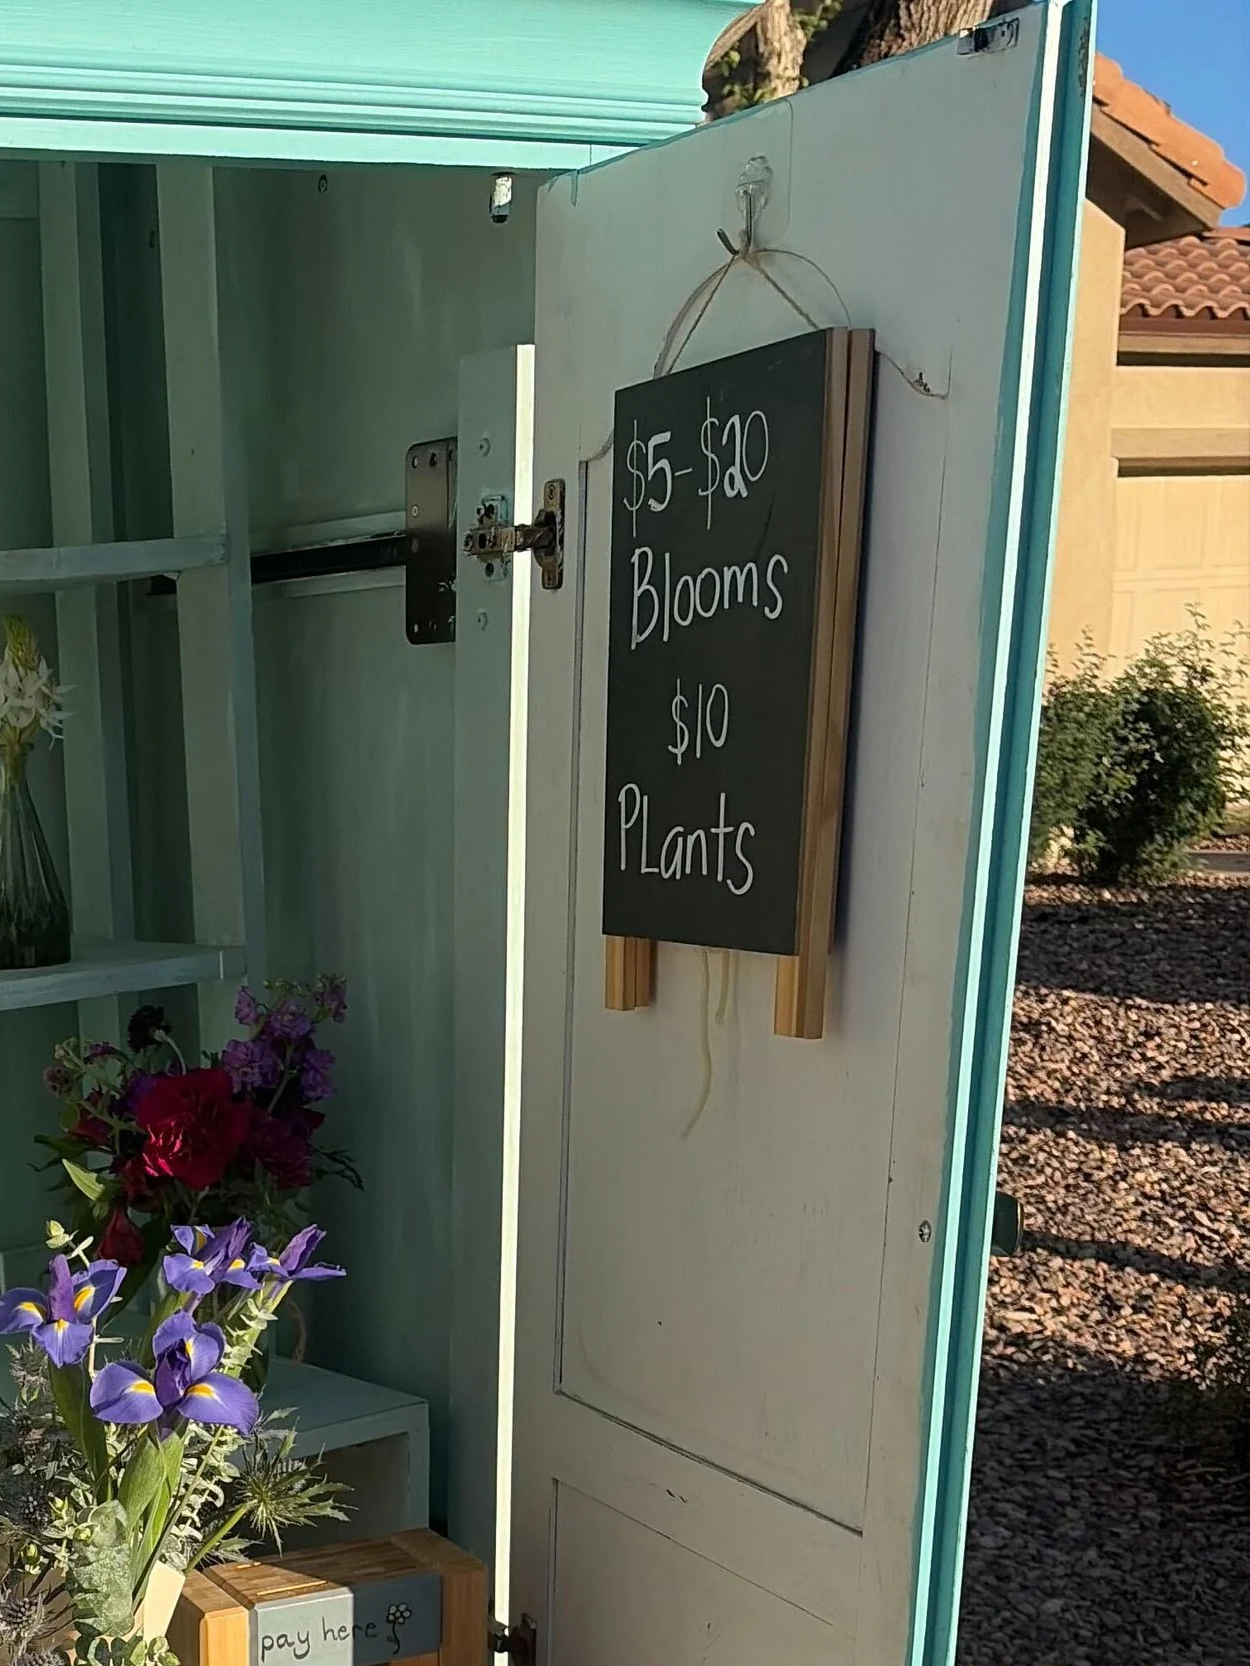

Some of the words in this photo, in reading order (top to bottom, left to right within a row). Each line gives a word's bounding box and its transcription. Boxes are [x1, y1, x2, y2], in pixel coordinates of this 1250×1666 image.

[630, 546, 788, 650] Blooms
[667, 677, 729, 766] $10
[261, 1629, 310, 1663] pay
[322, 1616, 378, 1642] here
